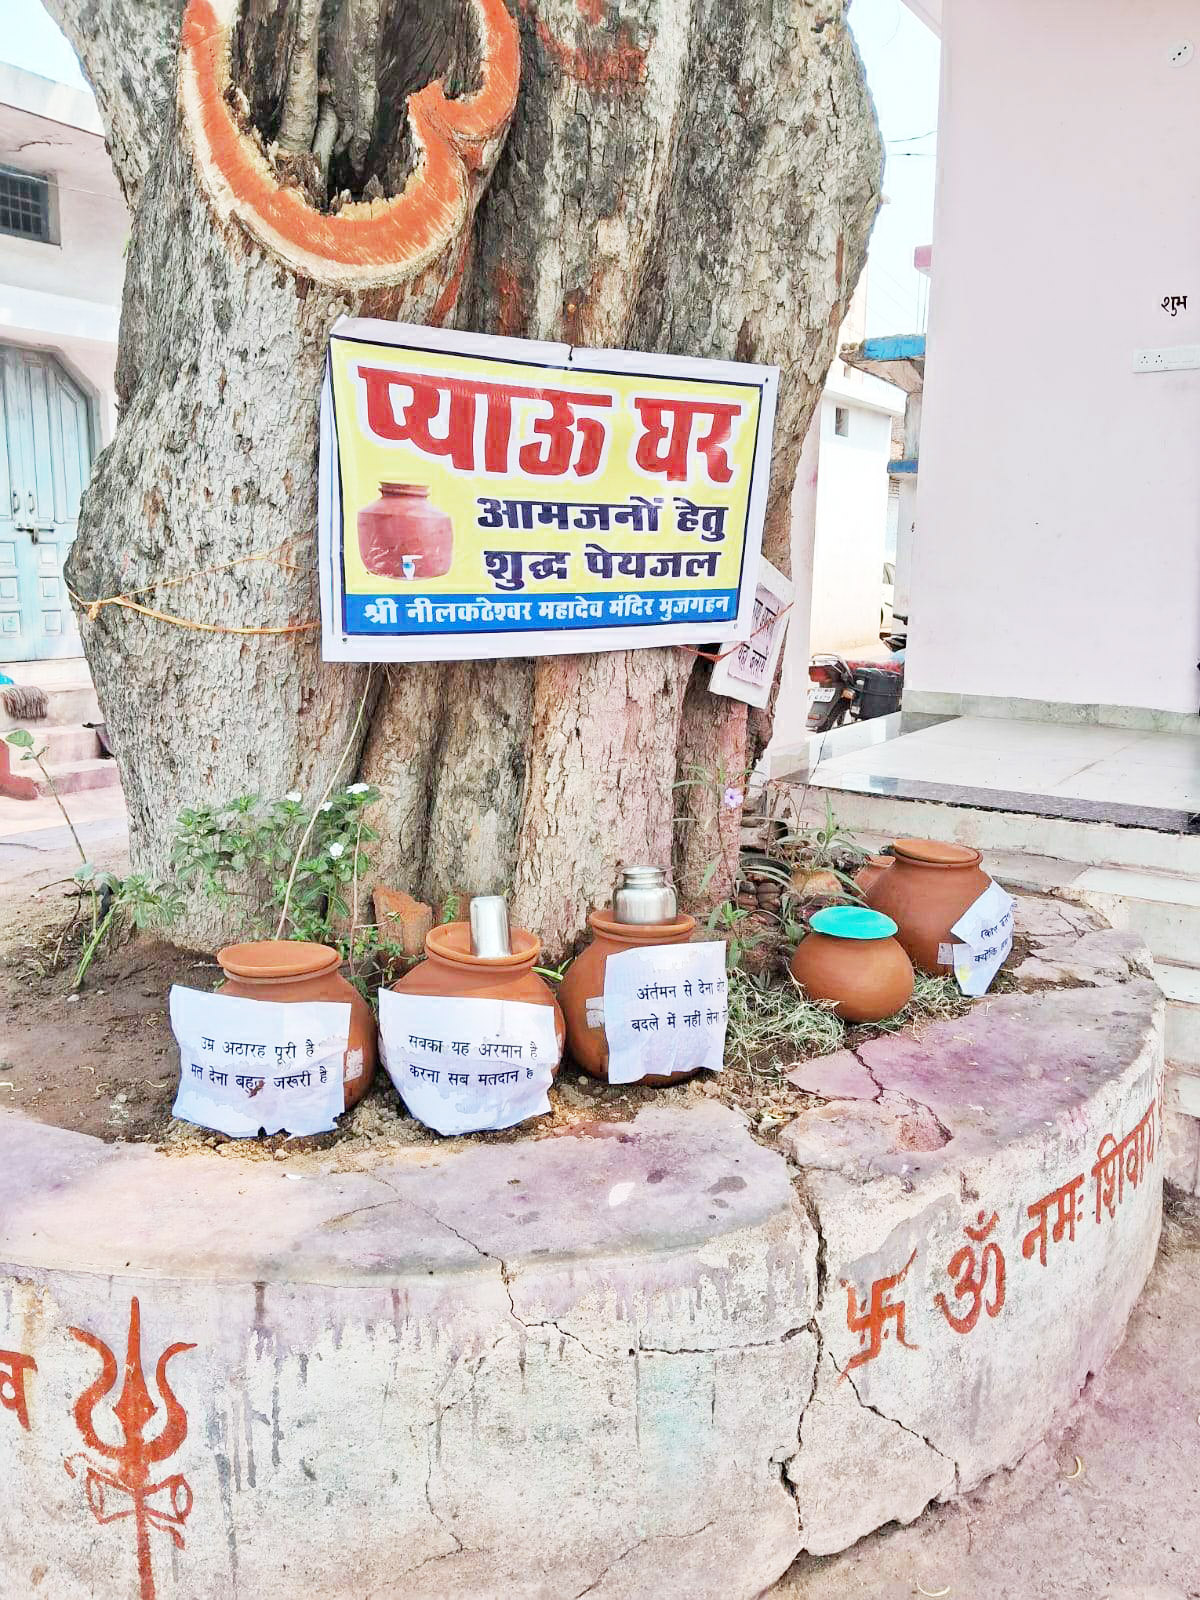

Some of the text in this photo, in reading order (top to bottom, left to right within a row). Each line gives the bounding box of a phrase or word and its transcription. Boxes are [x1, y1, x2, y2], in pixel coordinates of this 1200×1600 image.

[1160, 295, 1188, 317] शुभ
[357, 365, 741, 483] प्याऊ घर
[477, 497, 729, 542] आमजनों हेतु
[484, 543, 722, 590] शुद्ध पेयजल
[363, 598, 398, 624] श्री
[538, 596, 603, 620] महादेव
[609, 594, 654, 617] मंदिर
[659, 596, 730, 621] मुजगहन
[683, 980, 692, 997] से
[698, 979, 713, 995] देना
[631, 1013, 659, 1032] बदले
[667, 1012, 676, 1028] में
[683, 1010, 701, 1028] नहीं
[222, 1041, 267, 1058] अठारह
[275, 1041, 296, 1065] पूरी
[306, 1039, 315, 1058] है
[409, 1035, 444, 1054] सबका
[452, 1041, 471, 1056] यह
[191, 1064, 203, 1081] मत
[209, 1065, 228, 1086] देना
[273, 1070, 313, 1089] जरूरी
[319, 1066, 328, 1083] है
[409, 1064, 441, 1083] करना
[448, 1072, 470, 1086] सब
[478, 1070, 519, 1086] मतदान
[1022, 1173, 1084, 1268] नमः
